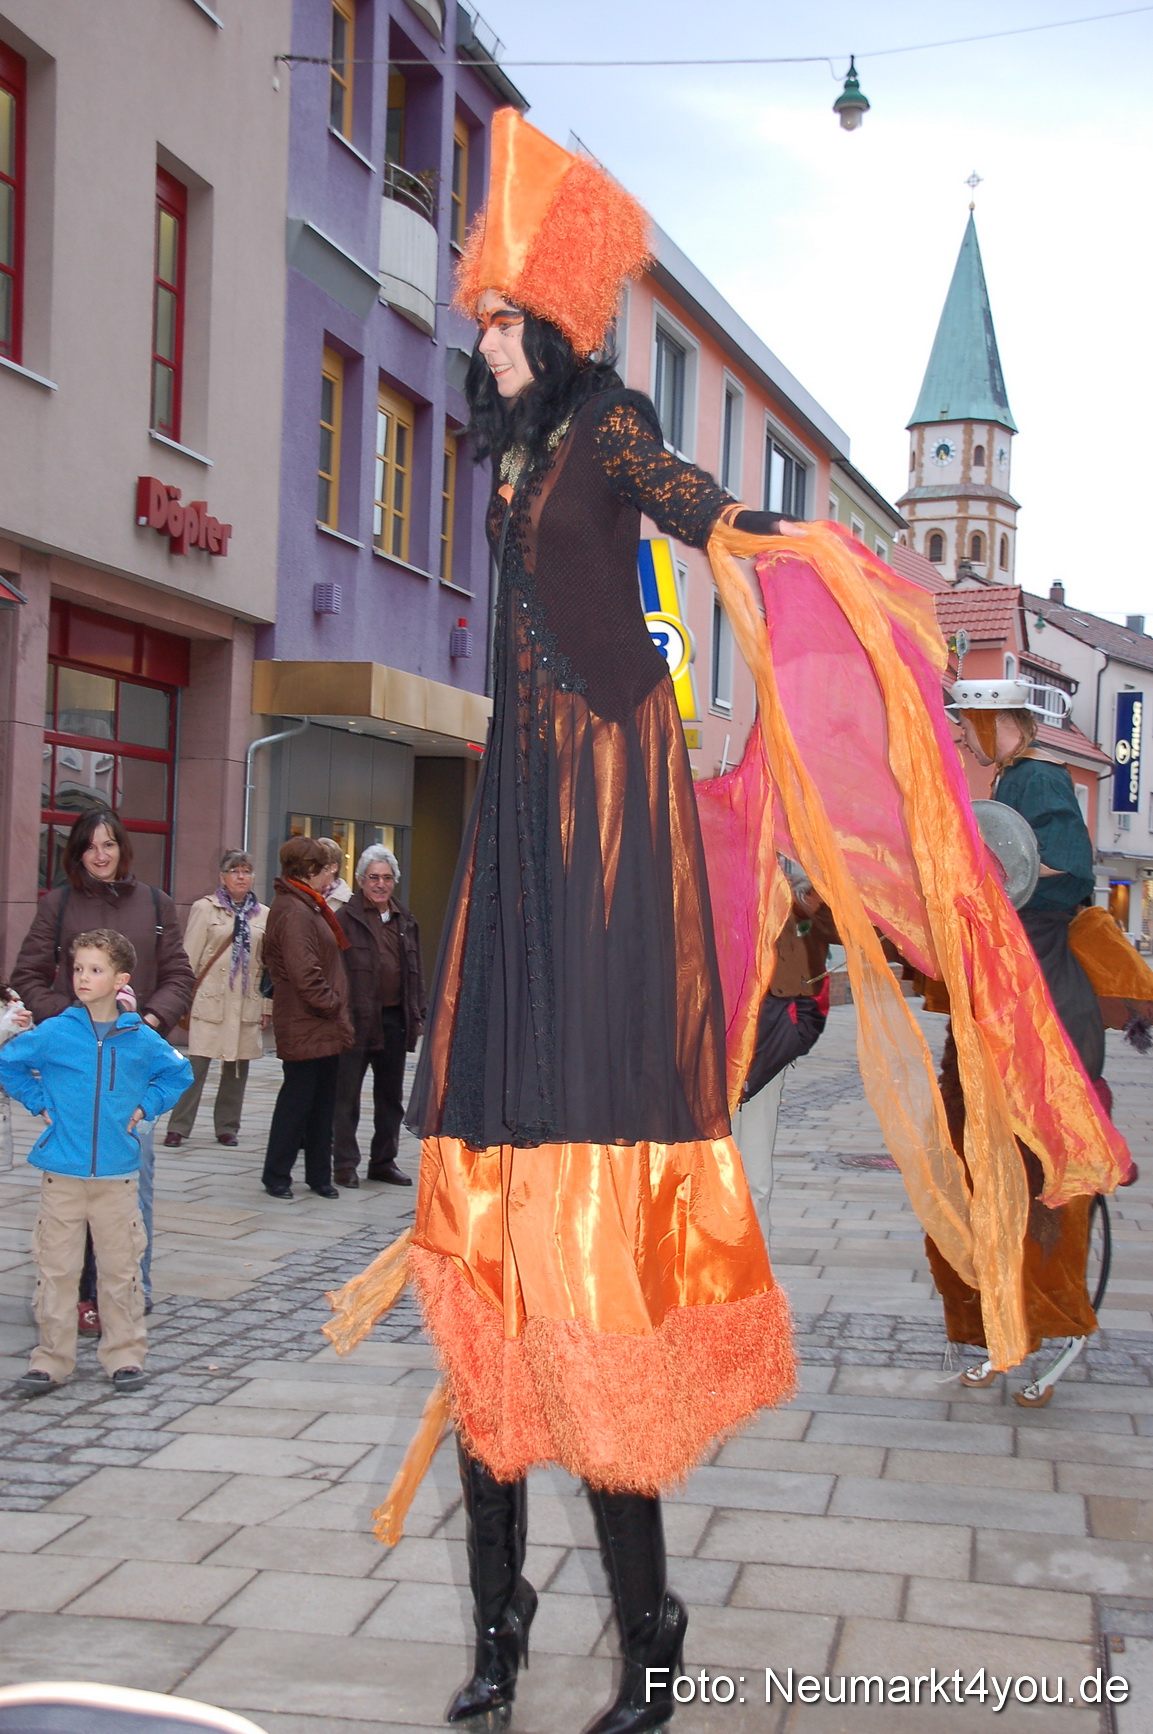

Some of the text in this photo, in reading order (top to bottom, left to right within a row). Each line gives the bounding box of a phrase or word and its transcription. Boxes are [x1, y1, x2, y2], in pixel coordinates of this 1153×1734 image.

[138, 476, 232, 556] Döpfer
[1129, 701, 1142, 803] TOM TAILOR
